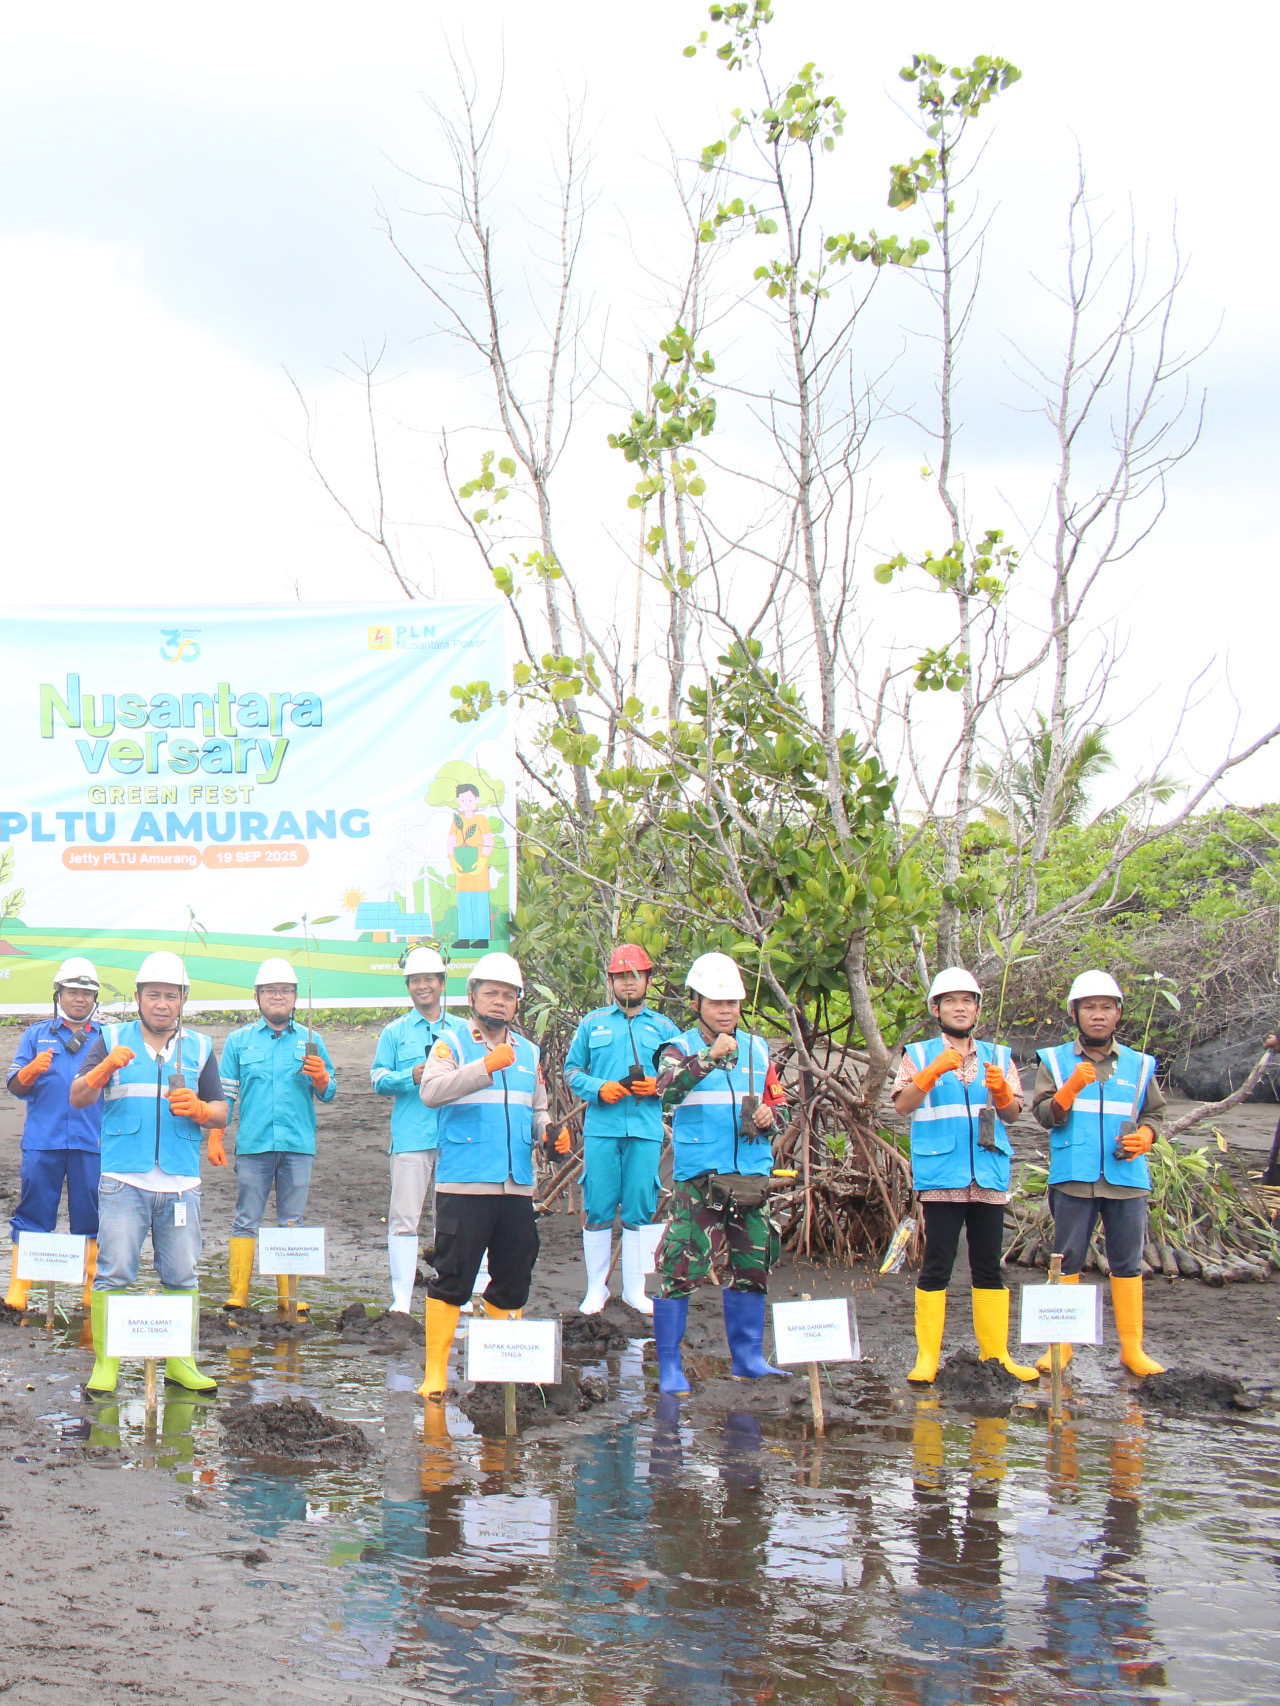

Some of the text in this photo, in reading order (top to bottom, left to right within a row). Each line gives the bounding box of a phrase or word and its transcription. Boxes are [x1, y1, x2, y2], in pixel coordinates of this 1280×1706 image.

[396, 625, 436, 638] PLN
[396, 639, 485, 650] Nusantara Power
[39, 673, 323, 738] Nusantara
[75, 731, 289, 783] versary
[88, 785, 254, 804] GREEN FEST
[0, 808, 370, 842] PLTU AMURANG
[68, 852, 197, 867] Jetty PLTU Amurang
[216, 850, 298, 863] 19 SEP 2025
